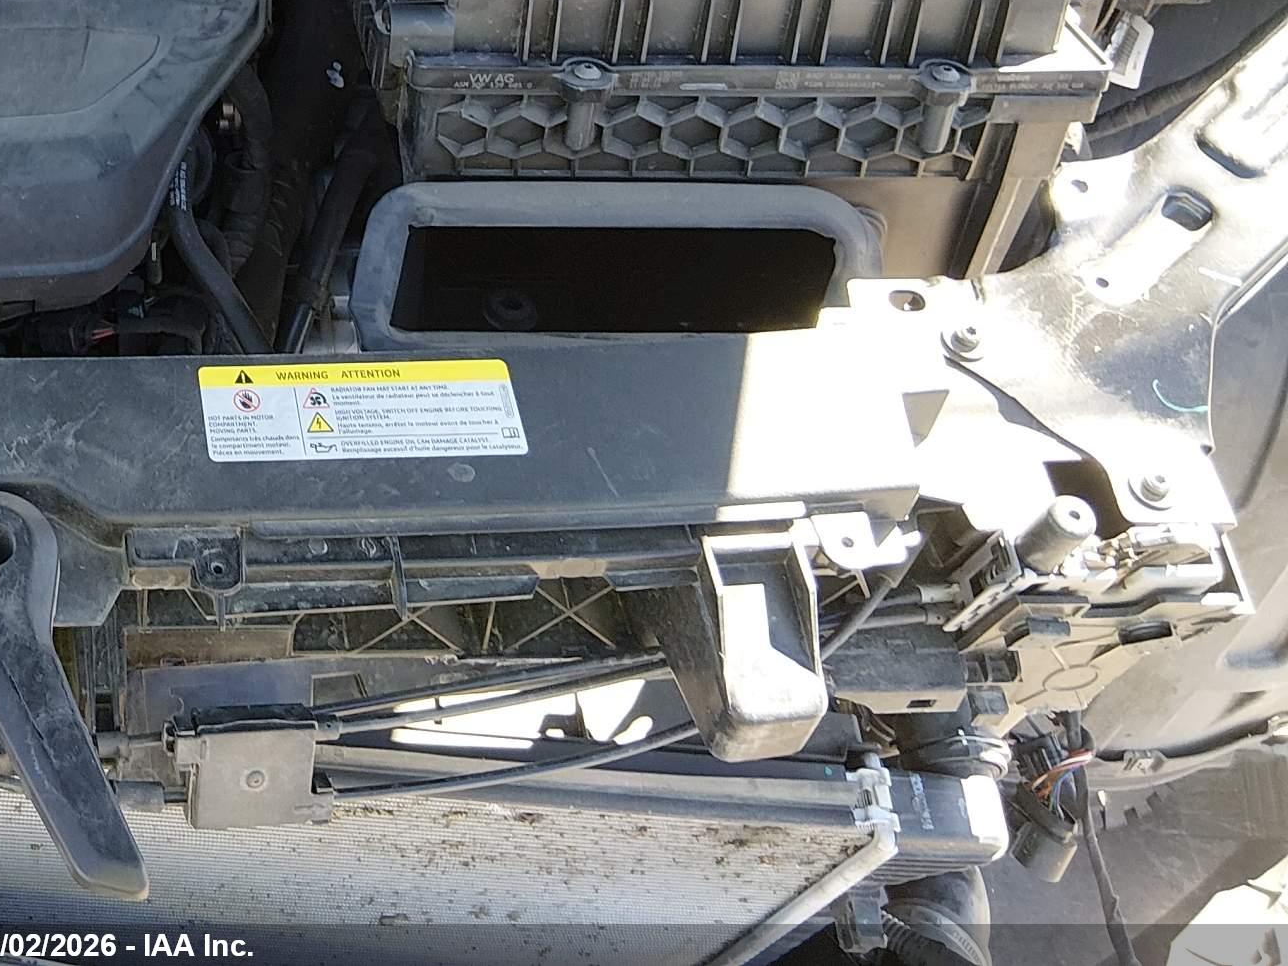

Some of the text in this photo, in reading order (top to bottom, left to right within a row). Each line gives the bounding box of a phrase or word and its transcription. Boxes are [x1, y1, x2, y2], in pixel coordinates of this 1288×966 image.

[494, 73, 515, 83] AG
[275, 369, 401, 380] WARNING ATTENTION
